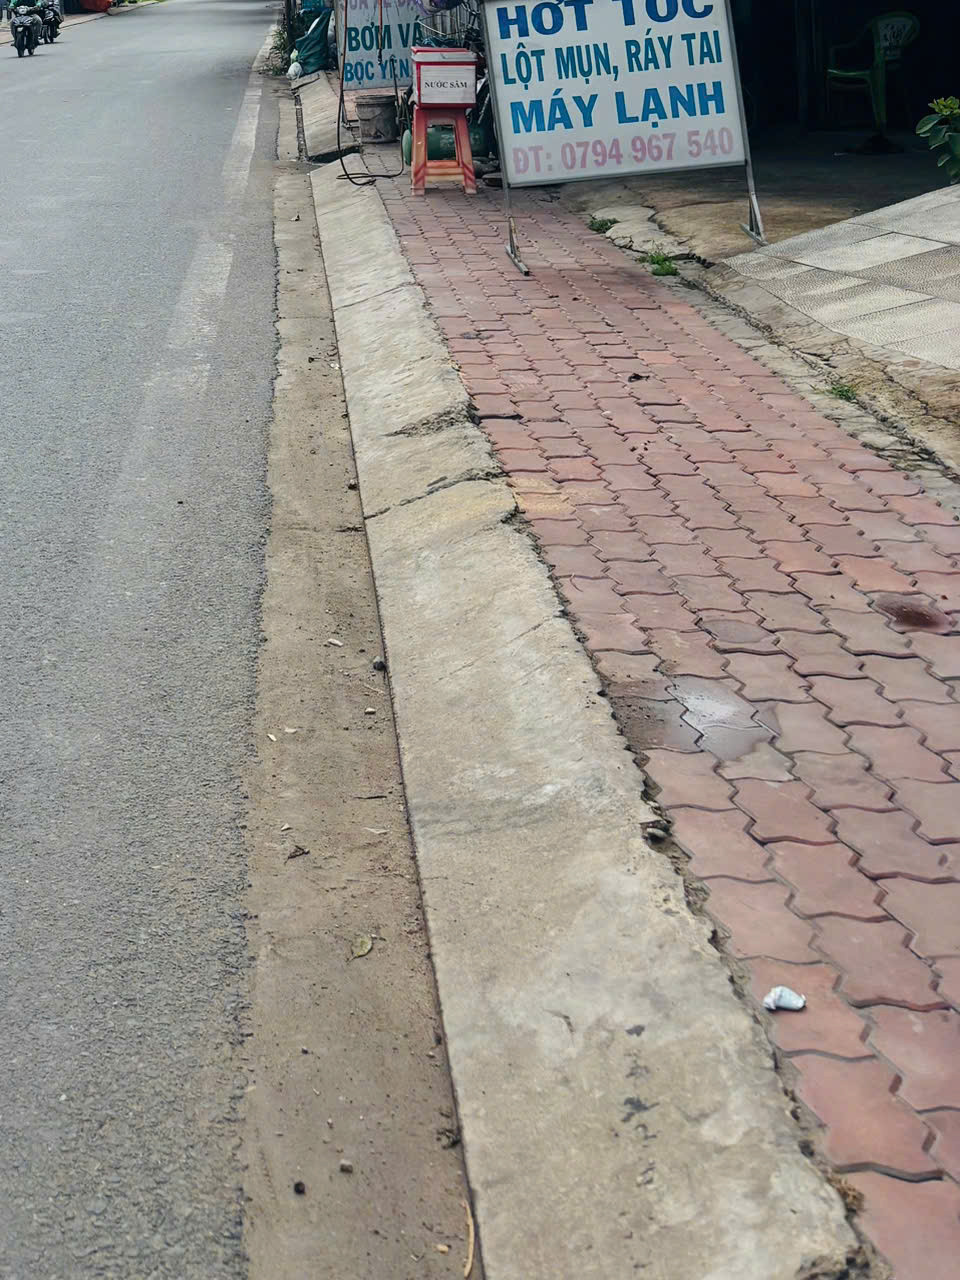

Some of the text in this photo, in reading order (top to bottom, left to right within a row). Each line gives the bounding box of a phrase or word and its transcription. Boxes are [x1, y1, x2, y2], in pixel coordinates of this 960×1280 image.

[347, 22, 392, 52] BƠM
[344, 61, 375, 86] BỌC
[500, 28, 723, 90] LỘT MỤN, RÁY TAI
[425, 79, 449, 89] NƯỚC
[510, 80, 726, 134] MÁY LẠNH
[512, 127, 734, 175] ĐT: 0794 967 540
